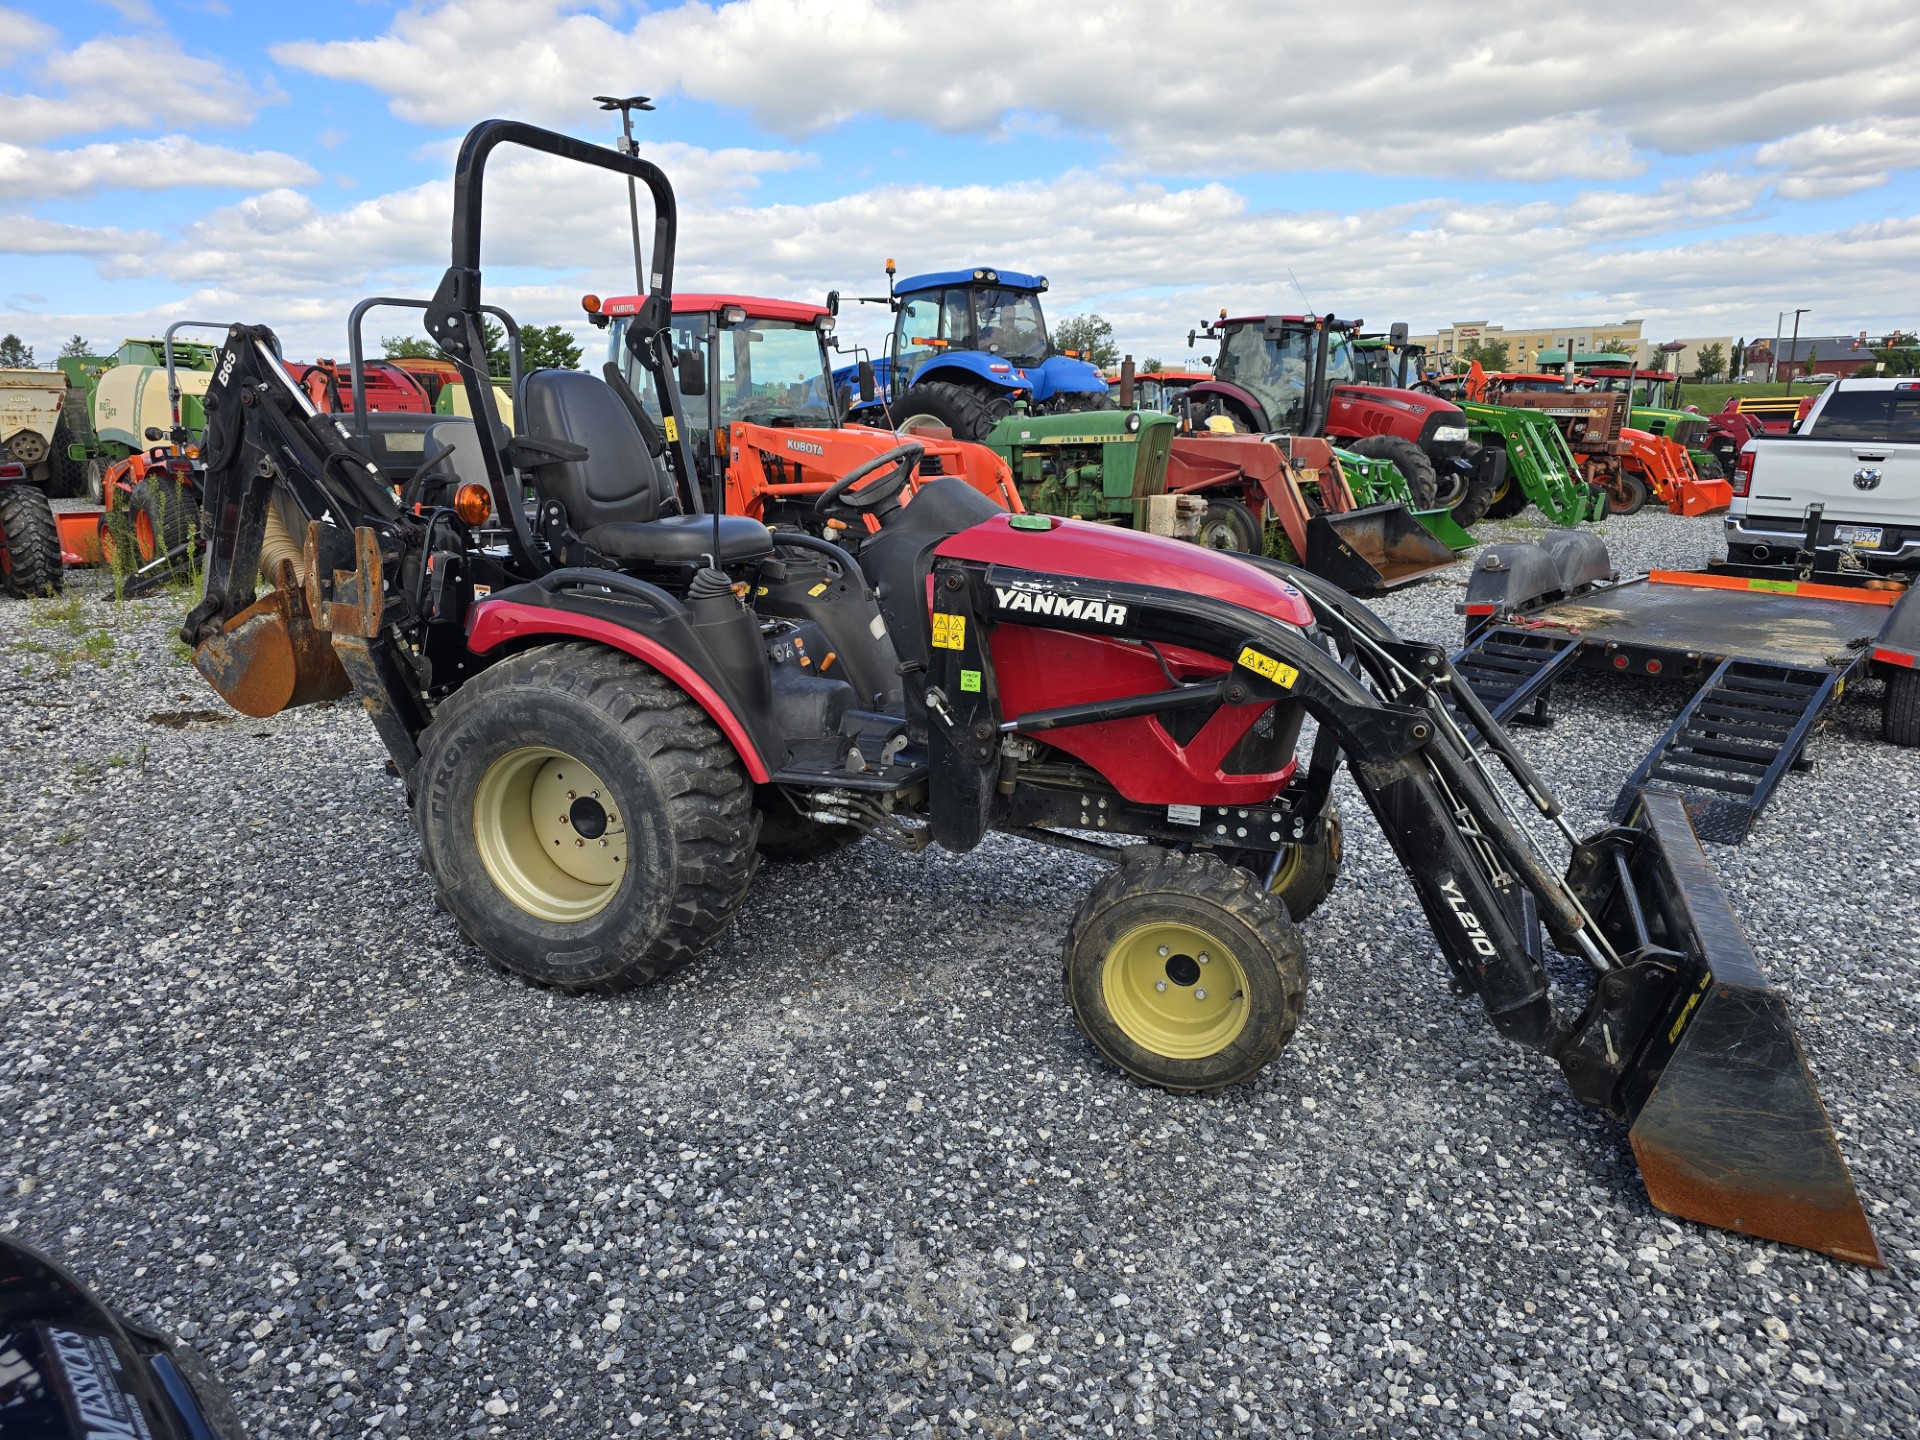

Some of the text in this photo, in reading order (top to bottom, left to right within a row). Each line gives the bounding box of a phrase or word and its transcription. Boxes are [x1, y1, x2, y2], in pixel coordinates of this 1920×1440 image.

[612, 304, 635, 313] KUBOTA
[218, 349, 237, 387] B65
[1410, 404, 1426, 414] 125
[787, 438, 824, 456] KUBOTA
[1856, 531, 1878, 542] 9525
[995, 587, 1127, 626] YANMAR
[432, 727, 479, 819] TIRON
[1440, 878, 1497, 956] YL210
[48, 1326, 143, 1440] MESSICK'S
